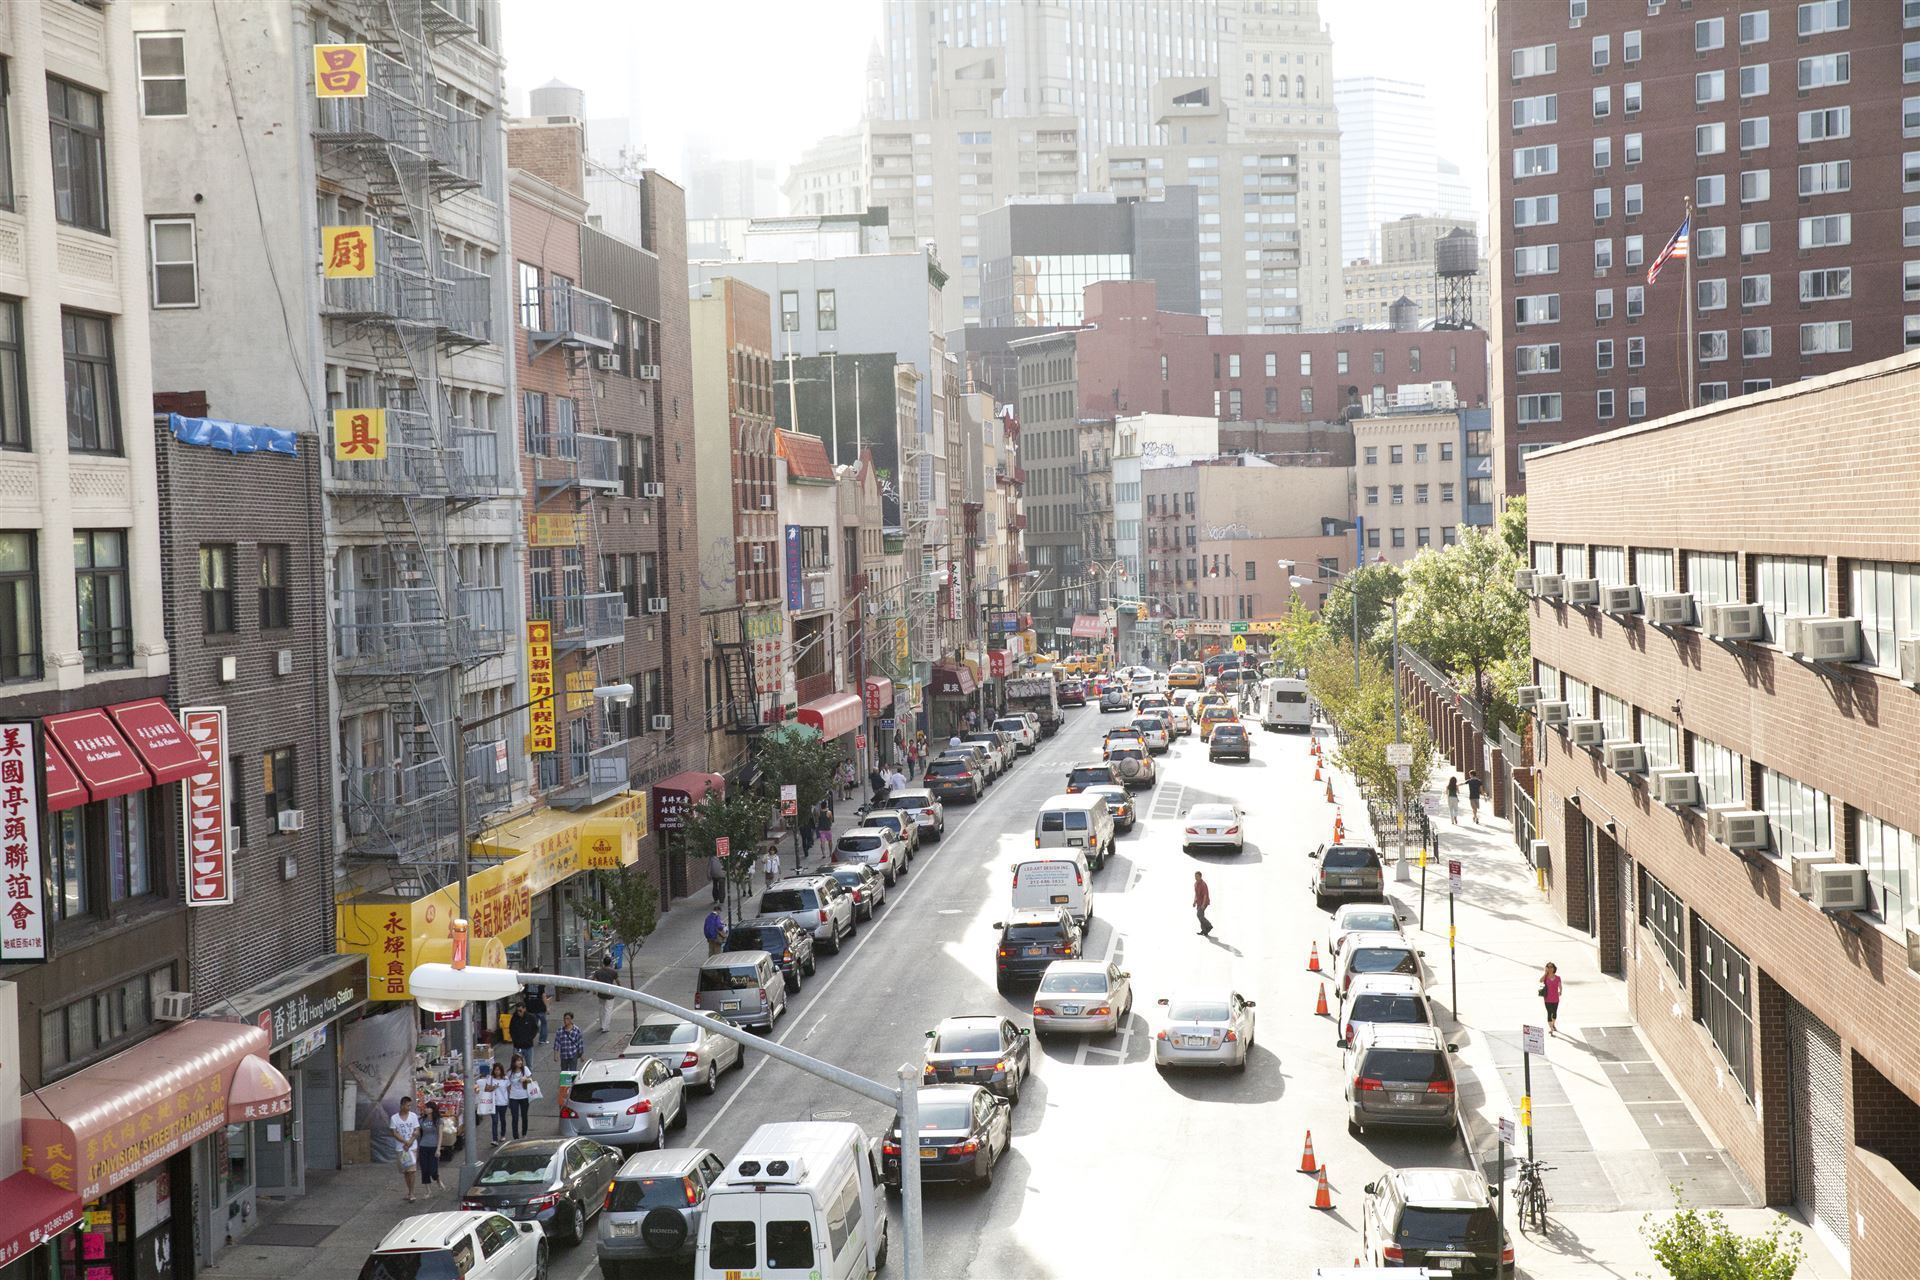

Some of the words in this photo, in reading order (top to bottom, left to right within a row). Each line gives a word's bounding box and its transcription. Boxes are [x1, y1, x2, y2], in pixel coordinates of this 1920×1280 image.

[321, 48, 361, 93] 昌
[328, 231, 368, 272] 厨
[340, 415, 379, 455] 具
[1477, 457, 1492, 473] 4
[530, 646, 553, 749] 日新電力工程公司
[1, 727, 36, 931] 美國亭頭聯誼會
[383, 911, 407, 994] 永輝食品
[274, 994, 309, 1040] 香港站
[309, 1003, 324, 1020] Hong
[324, 997, 337, 1013] Kong
[337, 987, 354, 1005] Station
[101, 1143, 142, 1177] DIVISION
[143, 1122, 174, 1155] STREET
[174, 1104, 209, 1136] TRADING
